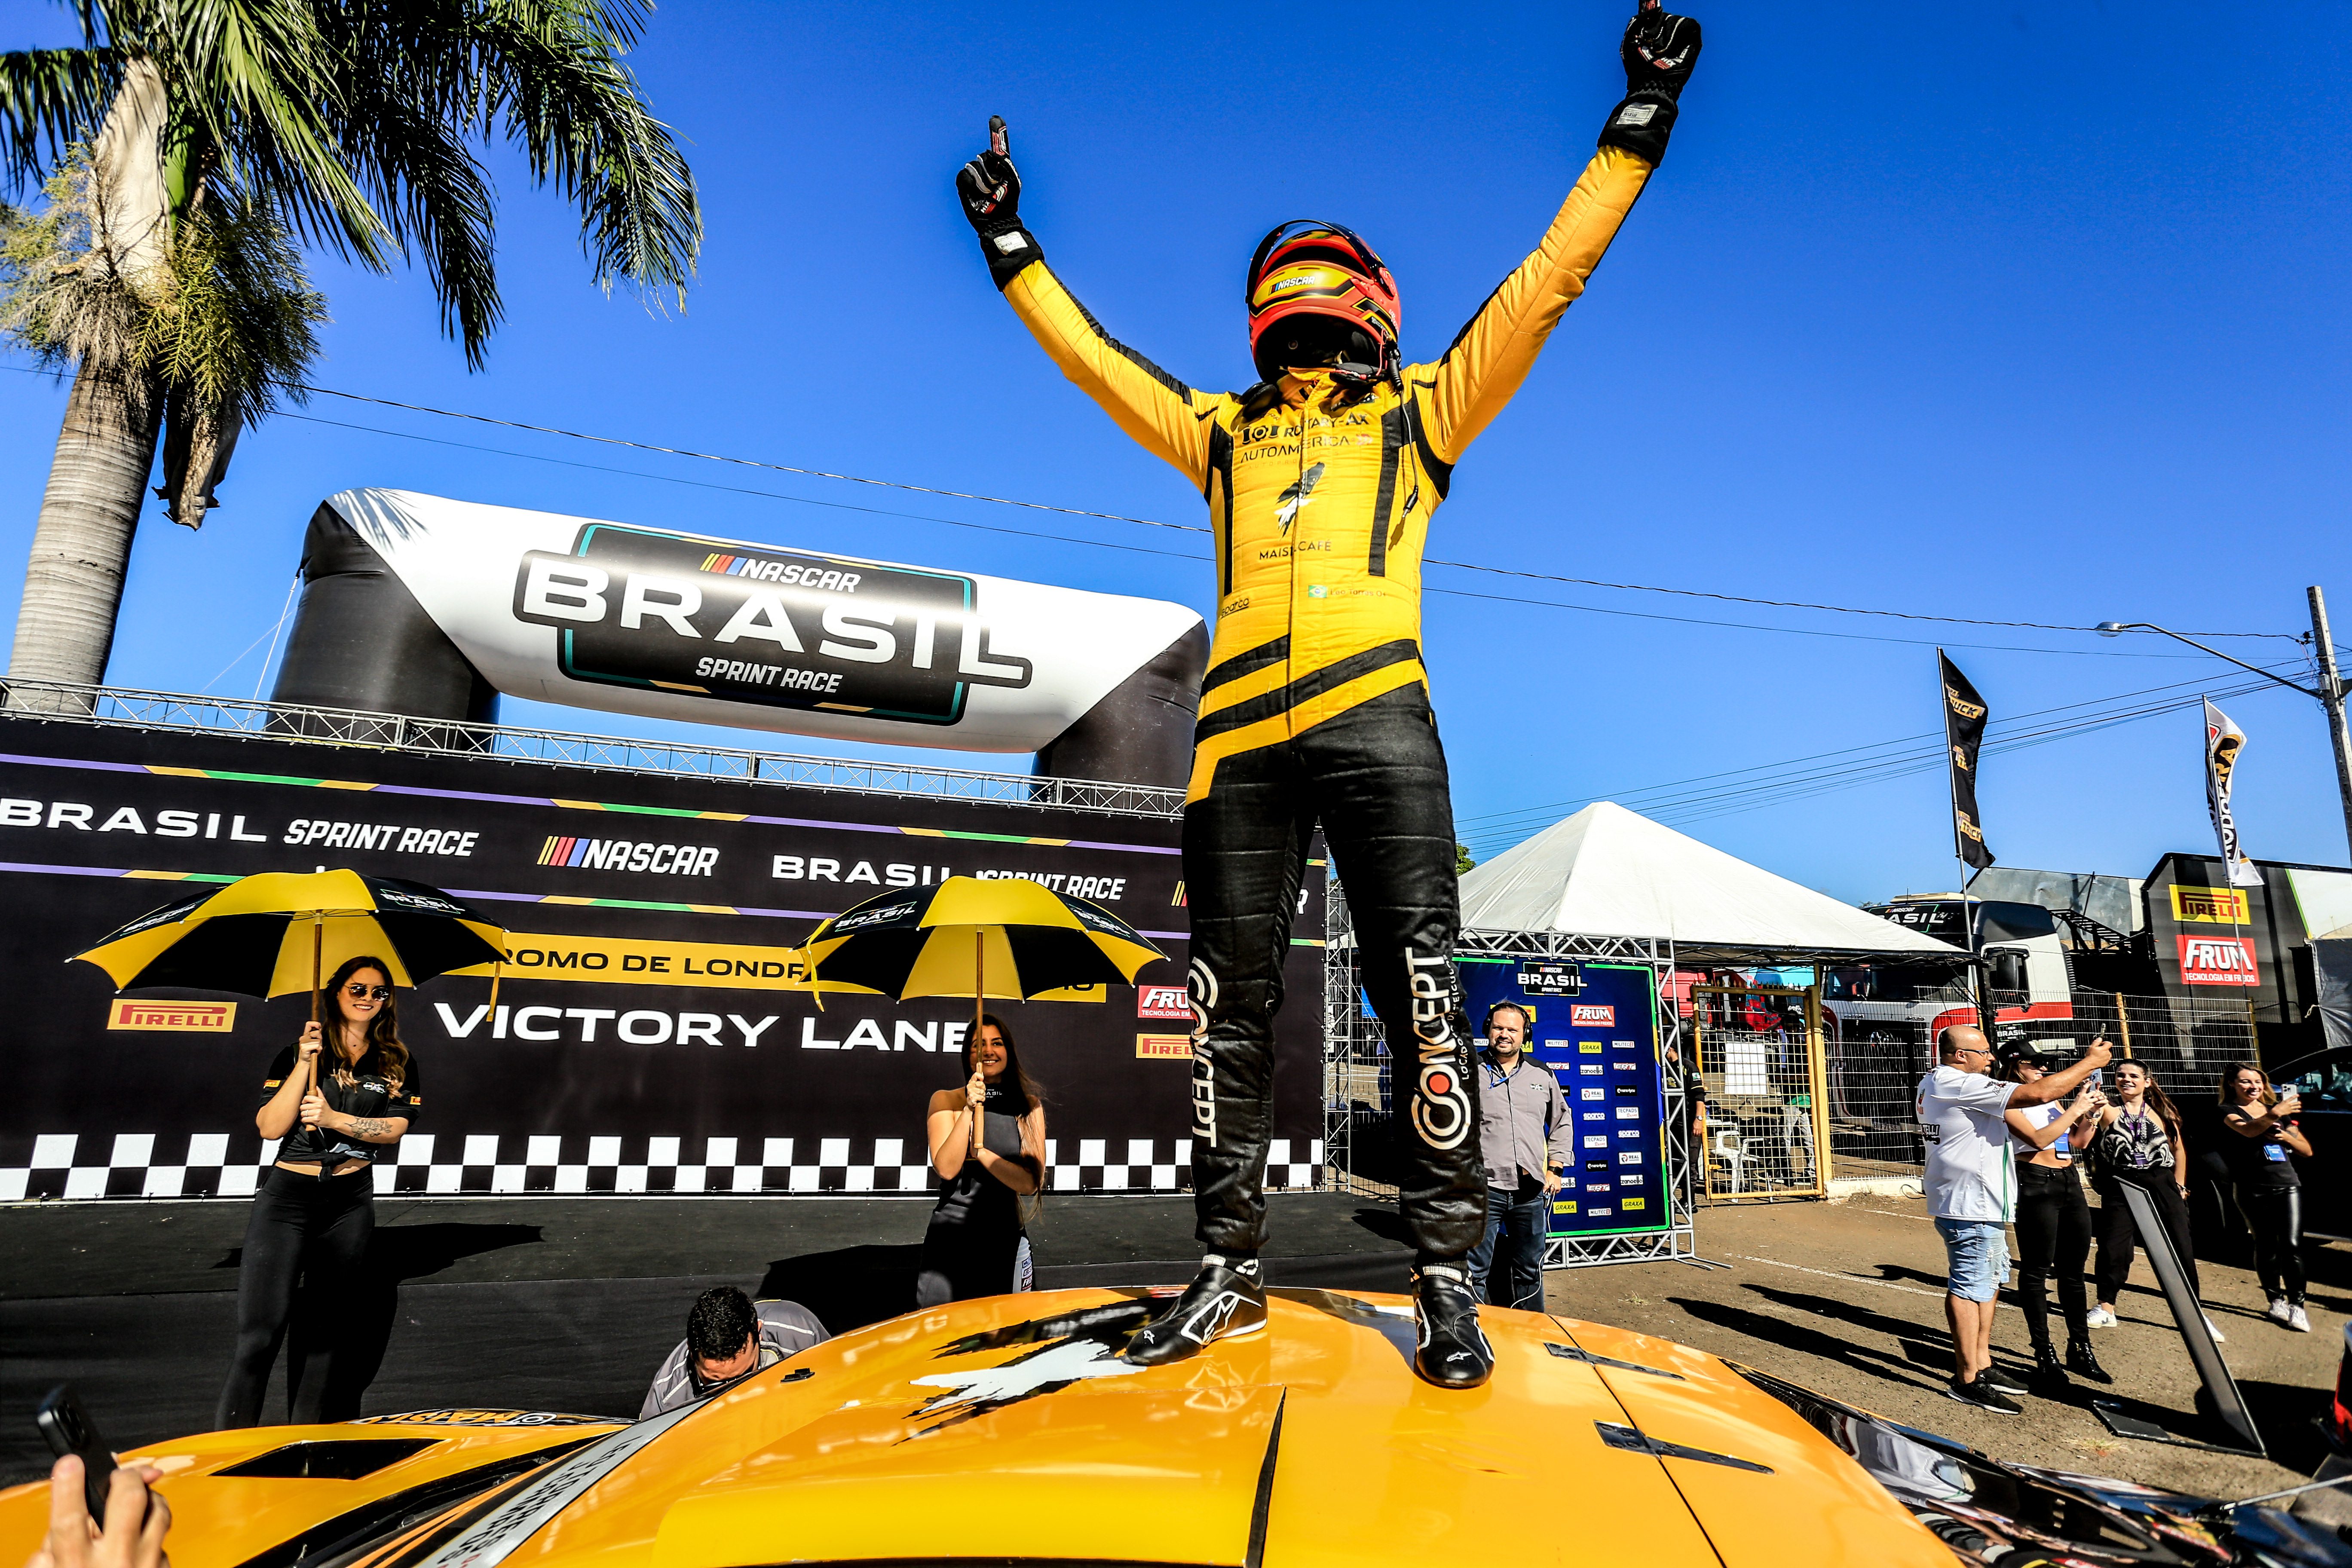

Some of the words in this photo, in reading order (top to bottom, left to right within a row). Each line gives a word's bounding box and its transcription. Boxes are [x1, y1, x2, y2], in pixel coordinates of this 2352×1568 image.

[1278, 276, 1315, 291] NASCAR
[738, 558, 861, 593] NASCAR
[522, 557, 1024, 681] BRASIL
[695, 656, 783, 688] SPRINT
[780, 667, 843, 693] RACE
[0, 798, 267, 843] BRASIL
[283, 819, 402, 852] SPRINT
[396, 826, 479, 857] RACE
[581, 840, 720, 877] NASCAR
[1065, 874, 1126, 900] RACE
[2179, 892, 2241, 917] PIRELLI
[835, 907, 915, 928] BRASIL
[1877, 913, 1944, 924] ASIL
[622, 955, 669, 974] DE
[2183, 939, 2254, 970] FRUM
[1517, 973, 1588, 987] BRASIL
[2185, 972, 2223, 981] TECNOLOGIA
[2233, 974, 2255, 983] FREIOS
[1142, 988, 1190, 1009] FRU
[119, 1004, 227, 1027] PIRELLI
[1574, 1007, 1612, 1020] FRUM
[434, 1001, 779, 1047] VICTORY
[800, 1017, 966, 1053] LANE
[1142, 1038, 1194, 1055] PIREL
[469, 1466, 597, 1553] TORRES
